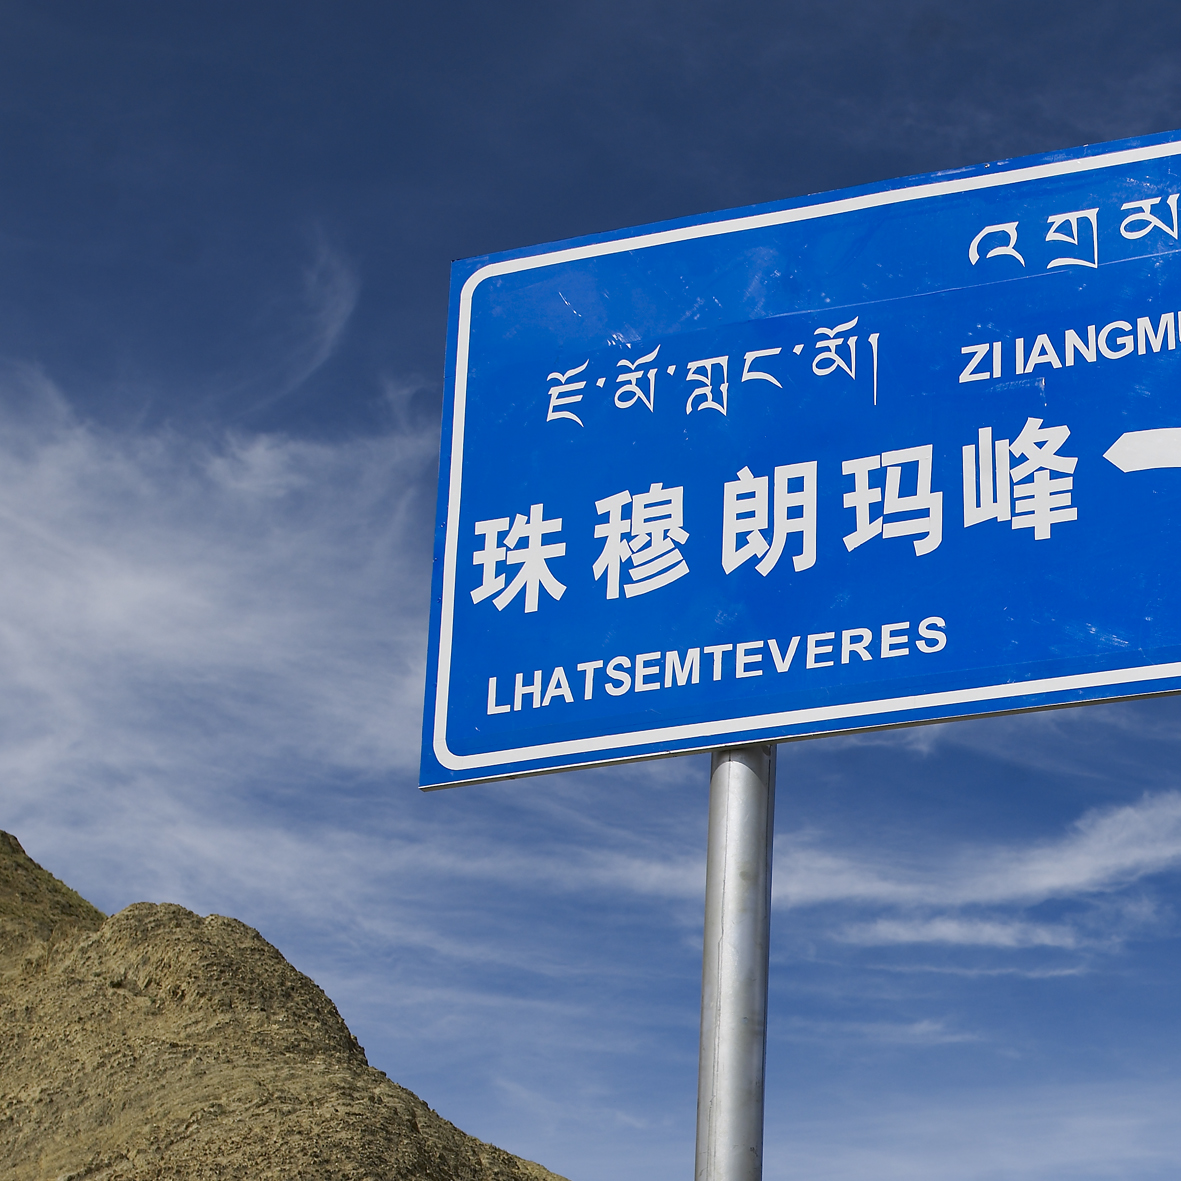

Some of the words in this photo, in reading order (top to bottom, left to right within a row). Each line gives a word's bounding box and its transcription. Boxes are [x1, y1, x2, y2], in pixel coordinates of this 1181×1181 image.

[469, 416, 1079, 614] 珠穆朗玛峰
